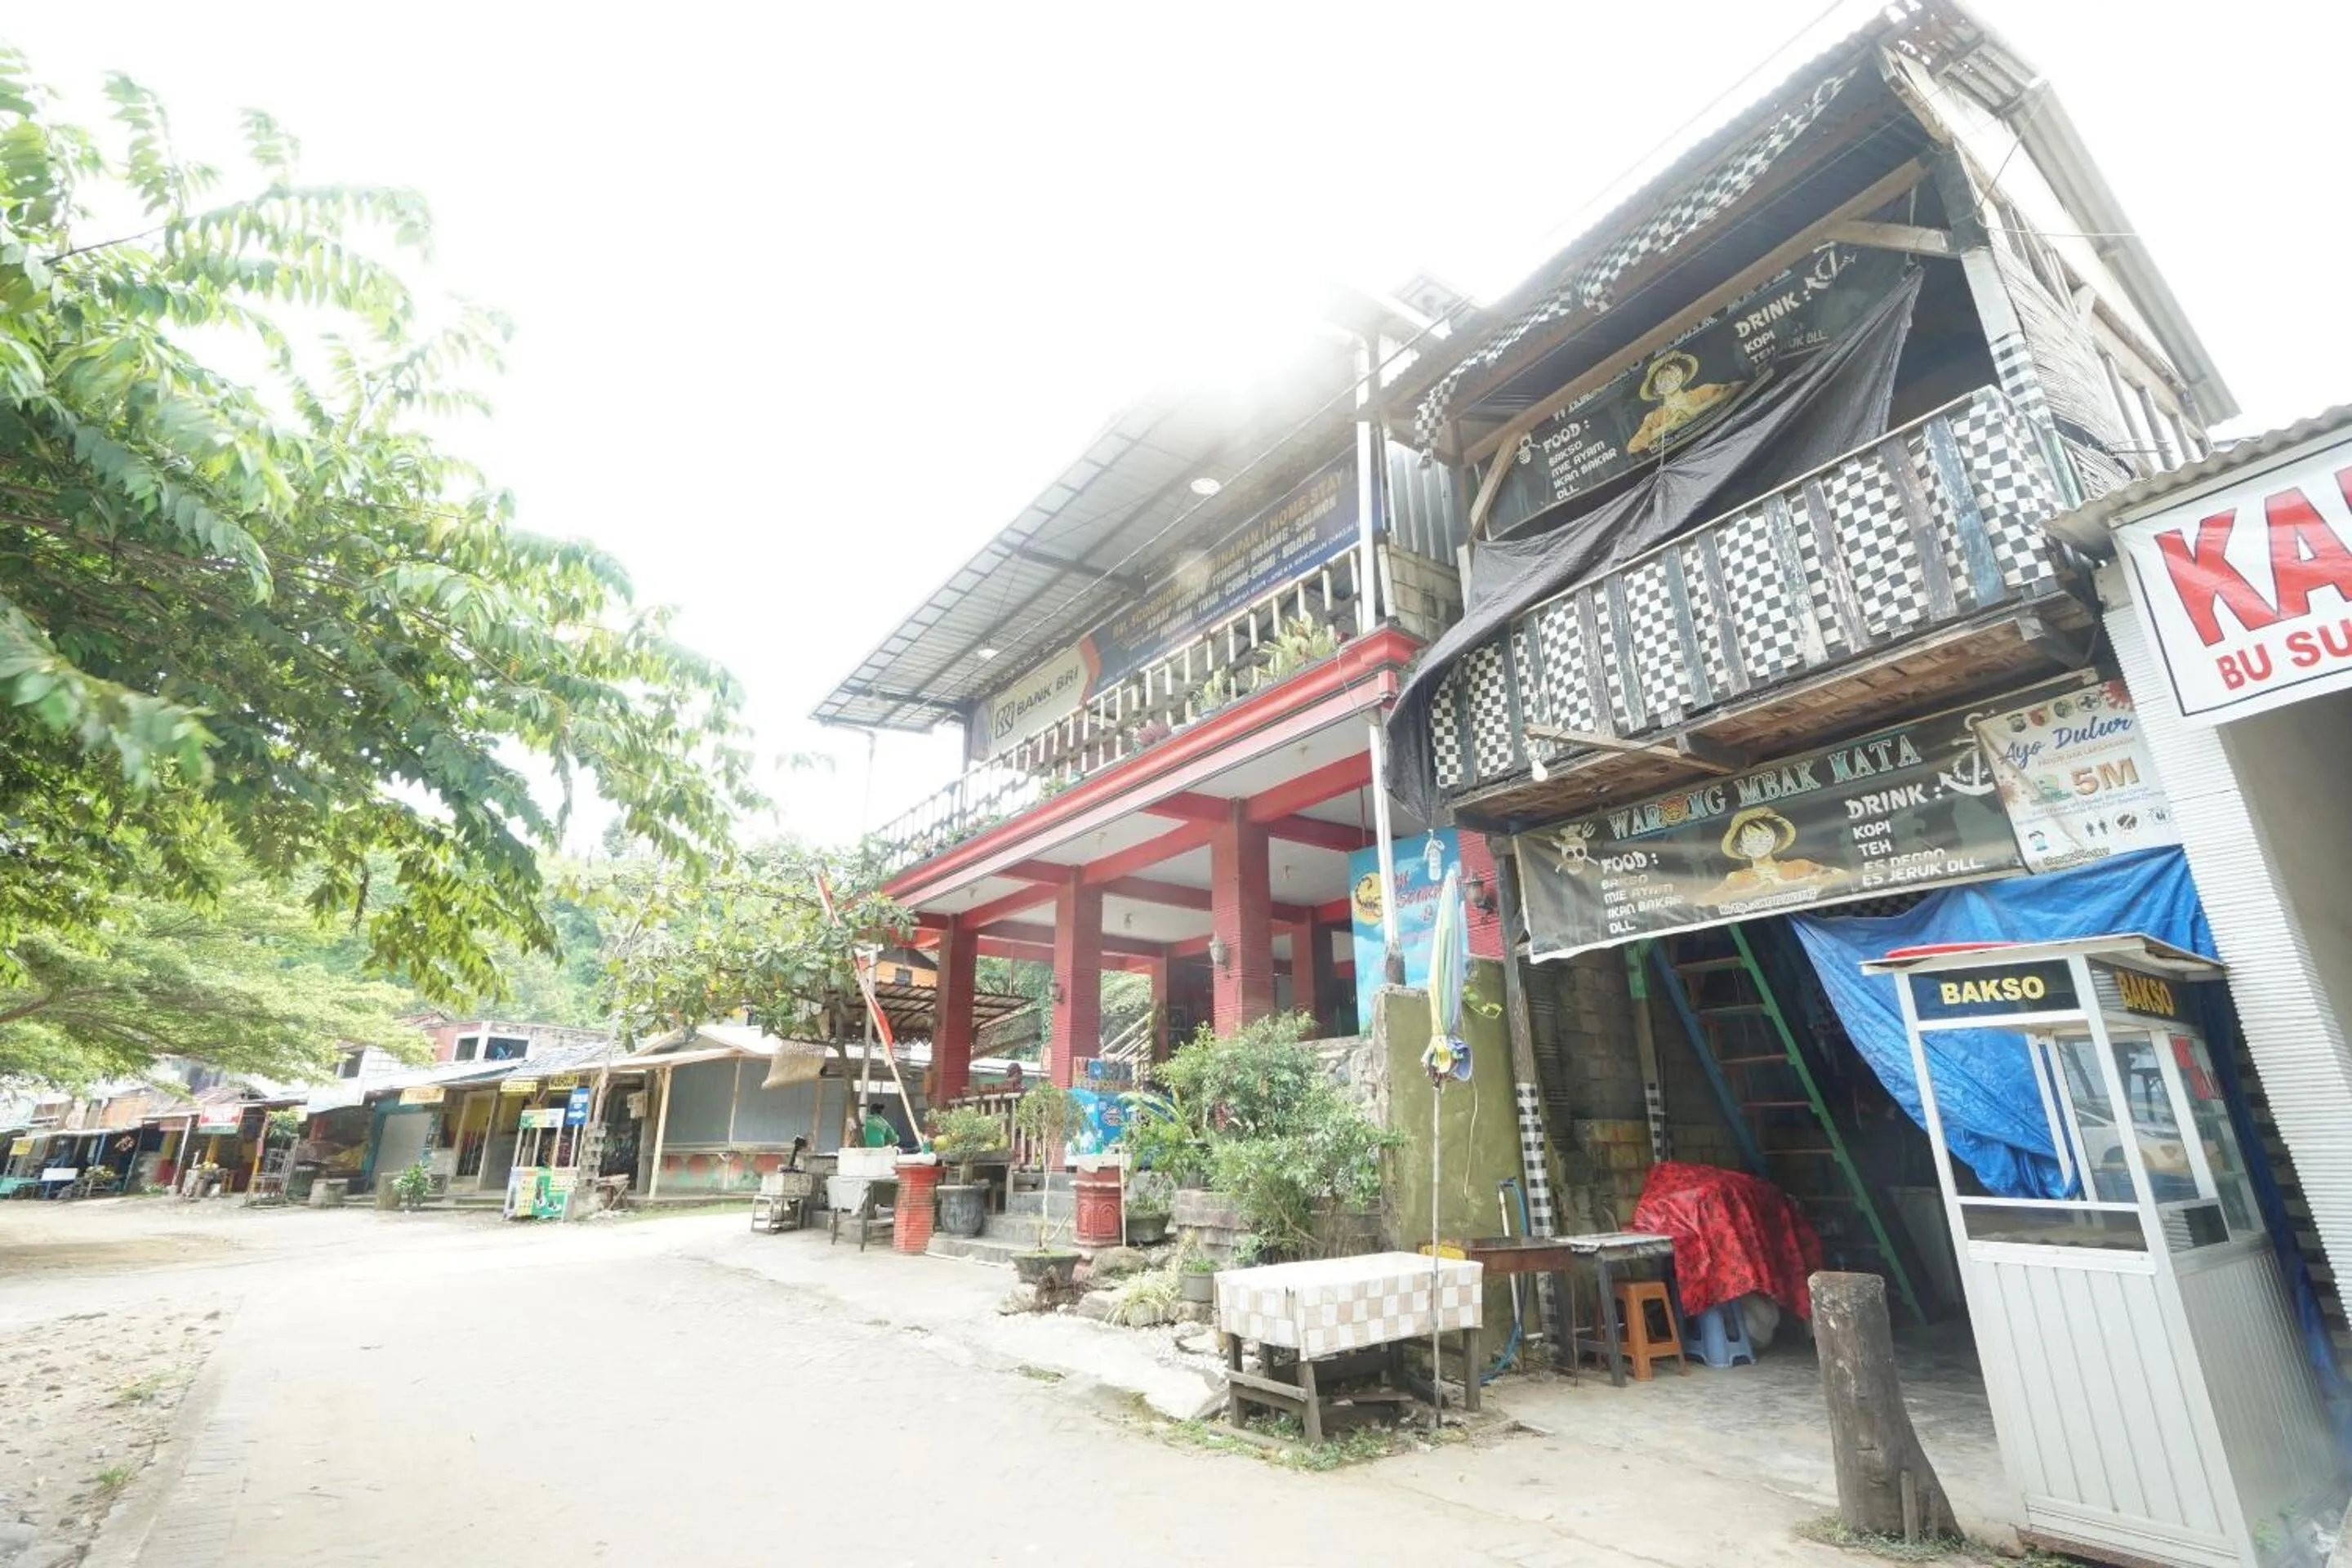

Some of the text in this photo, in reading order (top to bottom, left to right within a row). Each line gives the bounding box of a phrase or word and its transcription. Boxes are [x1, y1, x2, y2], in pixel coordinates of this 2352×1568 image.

[1734, 292, 1801, 338] DRINK
[1744, 330, 1775, 354] KOPI
[1543, 423, 1581, 453] FOOD
[2216, 644, 2272, 691] BU
[1017, 682, 1052, 715] BANK
[1998, 740, 2045, 770] Ayo
[2052, 716, 2133, 749] Dulur
[2071, 756, 2140, 795] 5M
[1608, 786, 1726, 840] WARNG
[1735, 760, 1822, 808] MBAK
[1844, 783, 1928, 819] DRINK
[1852, 819, 1891, 840] KOPI
[1601, 851, 1647, 875] FOOD
[1858, 839, 1892, 857] TEH
[1862, 874, 1884, 887] ES
[1888, 863, 1943, 883] JERUK
[1940, 975, 2045, 1004] BAKSO
[2115, 970, 2174, 1017] BAKSO
